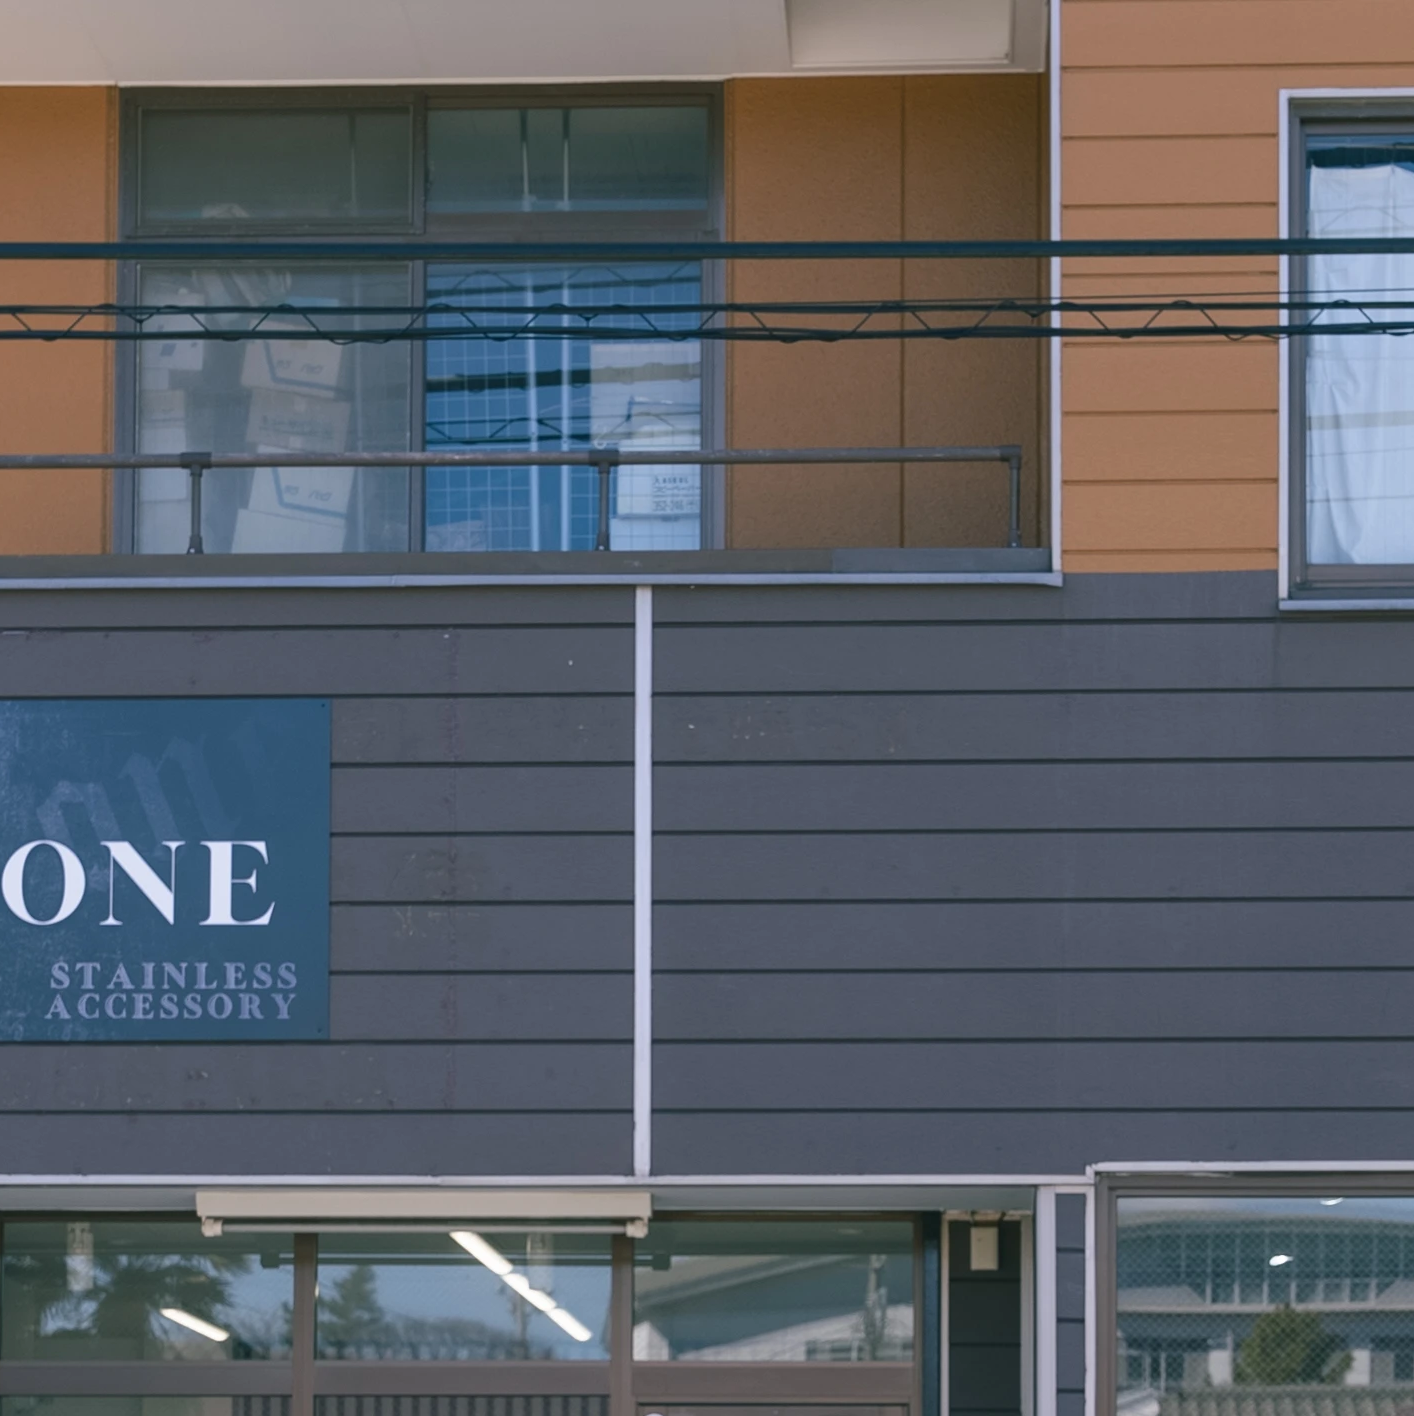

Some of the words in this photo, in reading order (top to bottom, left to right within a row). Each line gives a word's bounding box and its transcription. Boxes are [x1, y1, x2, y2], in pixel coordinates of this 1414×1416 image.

[1, 839, 275, 926] ONE
[50, 961, 297, 990] STAINLESS
[44, 992, 296, 1020] ACCESSORY
